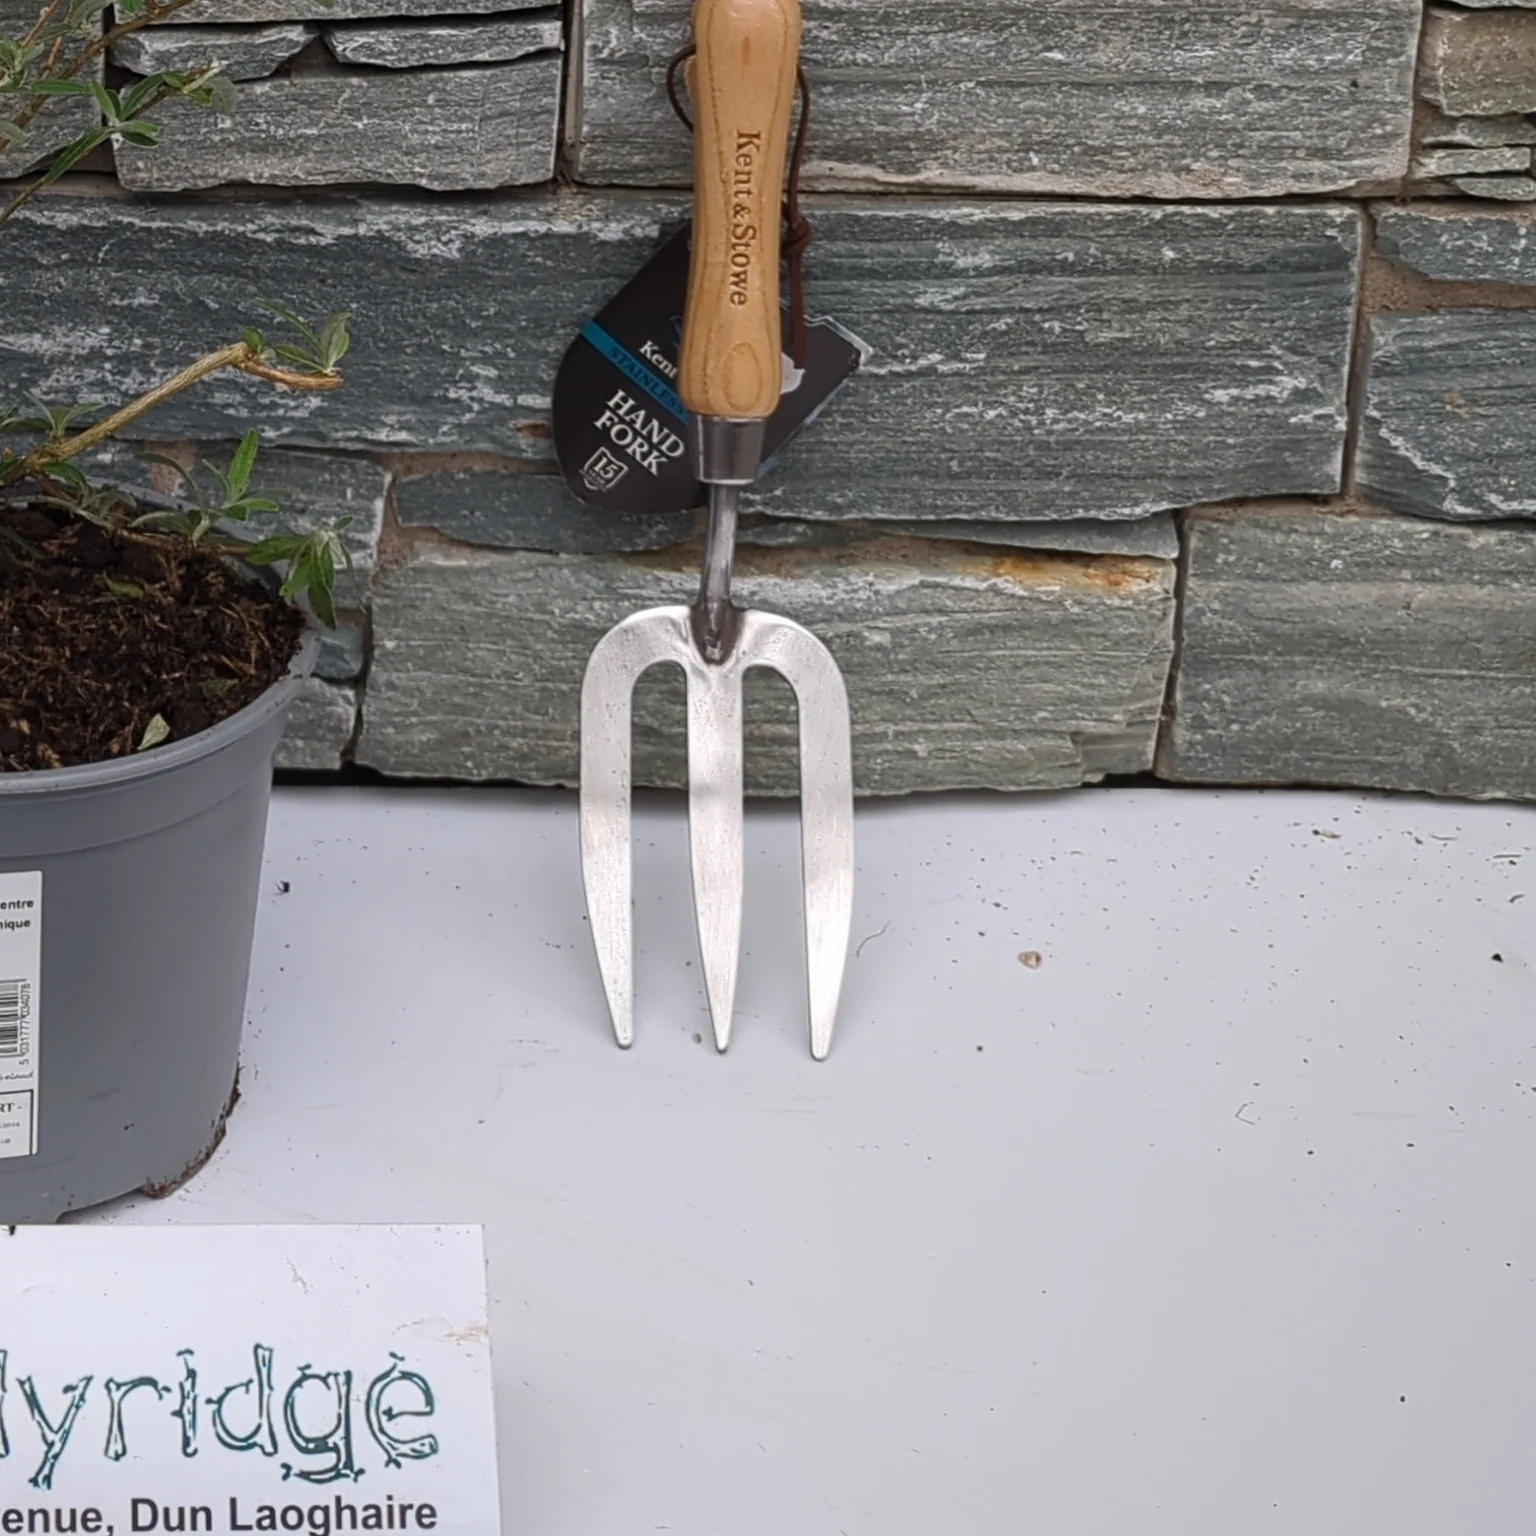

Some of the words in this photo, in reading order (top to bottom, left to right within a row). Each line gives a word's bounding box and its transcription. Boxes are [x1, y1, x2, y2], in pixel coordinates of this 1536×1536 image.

[733, 129, 761, 199] Kent
[732, 202, 750, 219] &
[729, 222, 757, 306] Stowe
[593, 410, 668, 477] FORK
[606, 389, 685, 458] HAND
[593, 457, 619, 478] 15
[131, 1497, 213, 1533] Dun
[230, 1495, 438, 1536] Laoghaire
